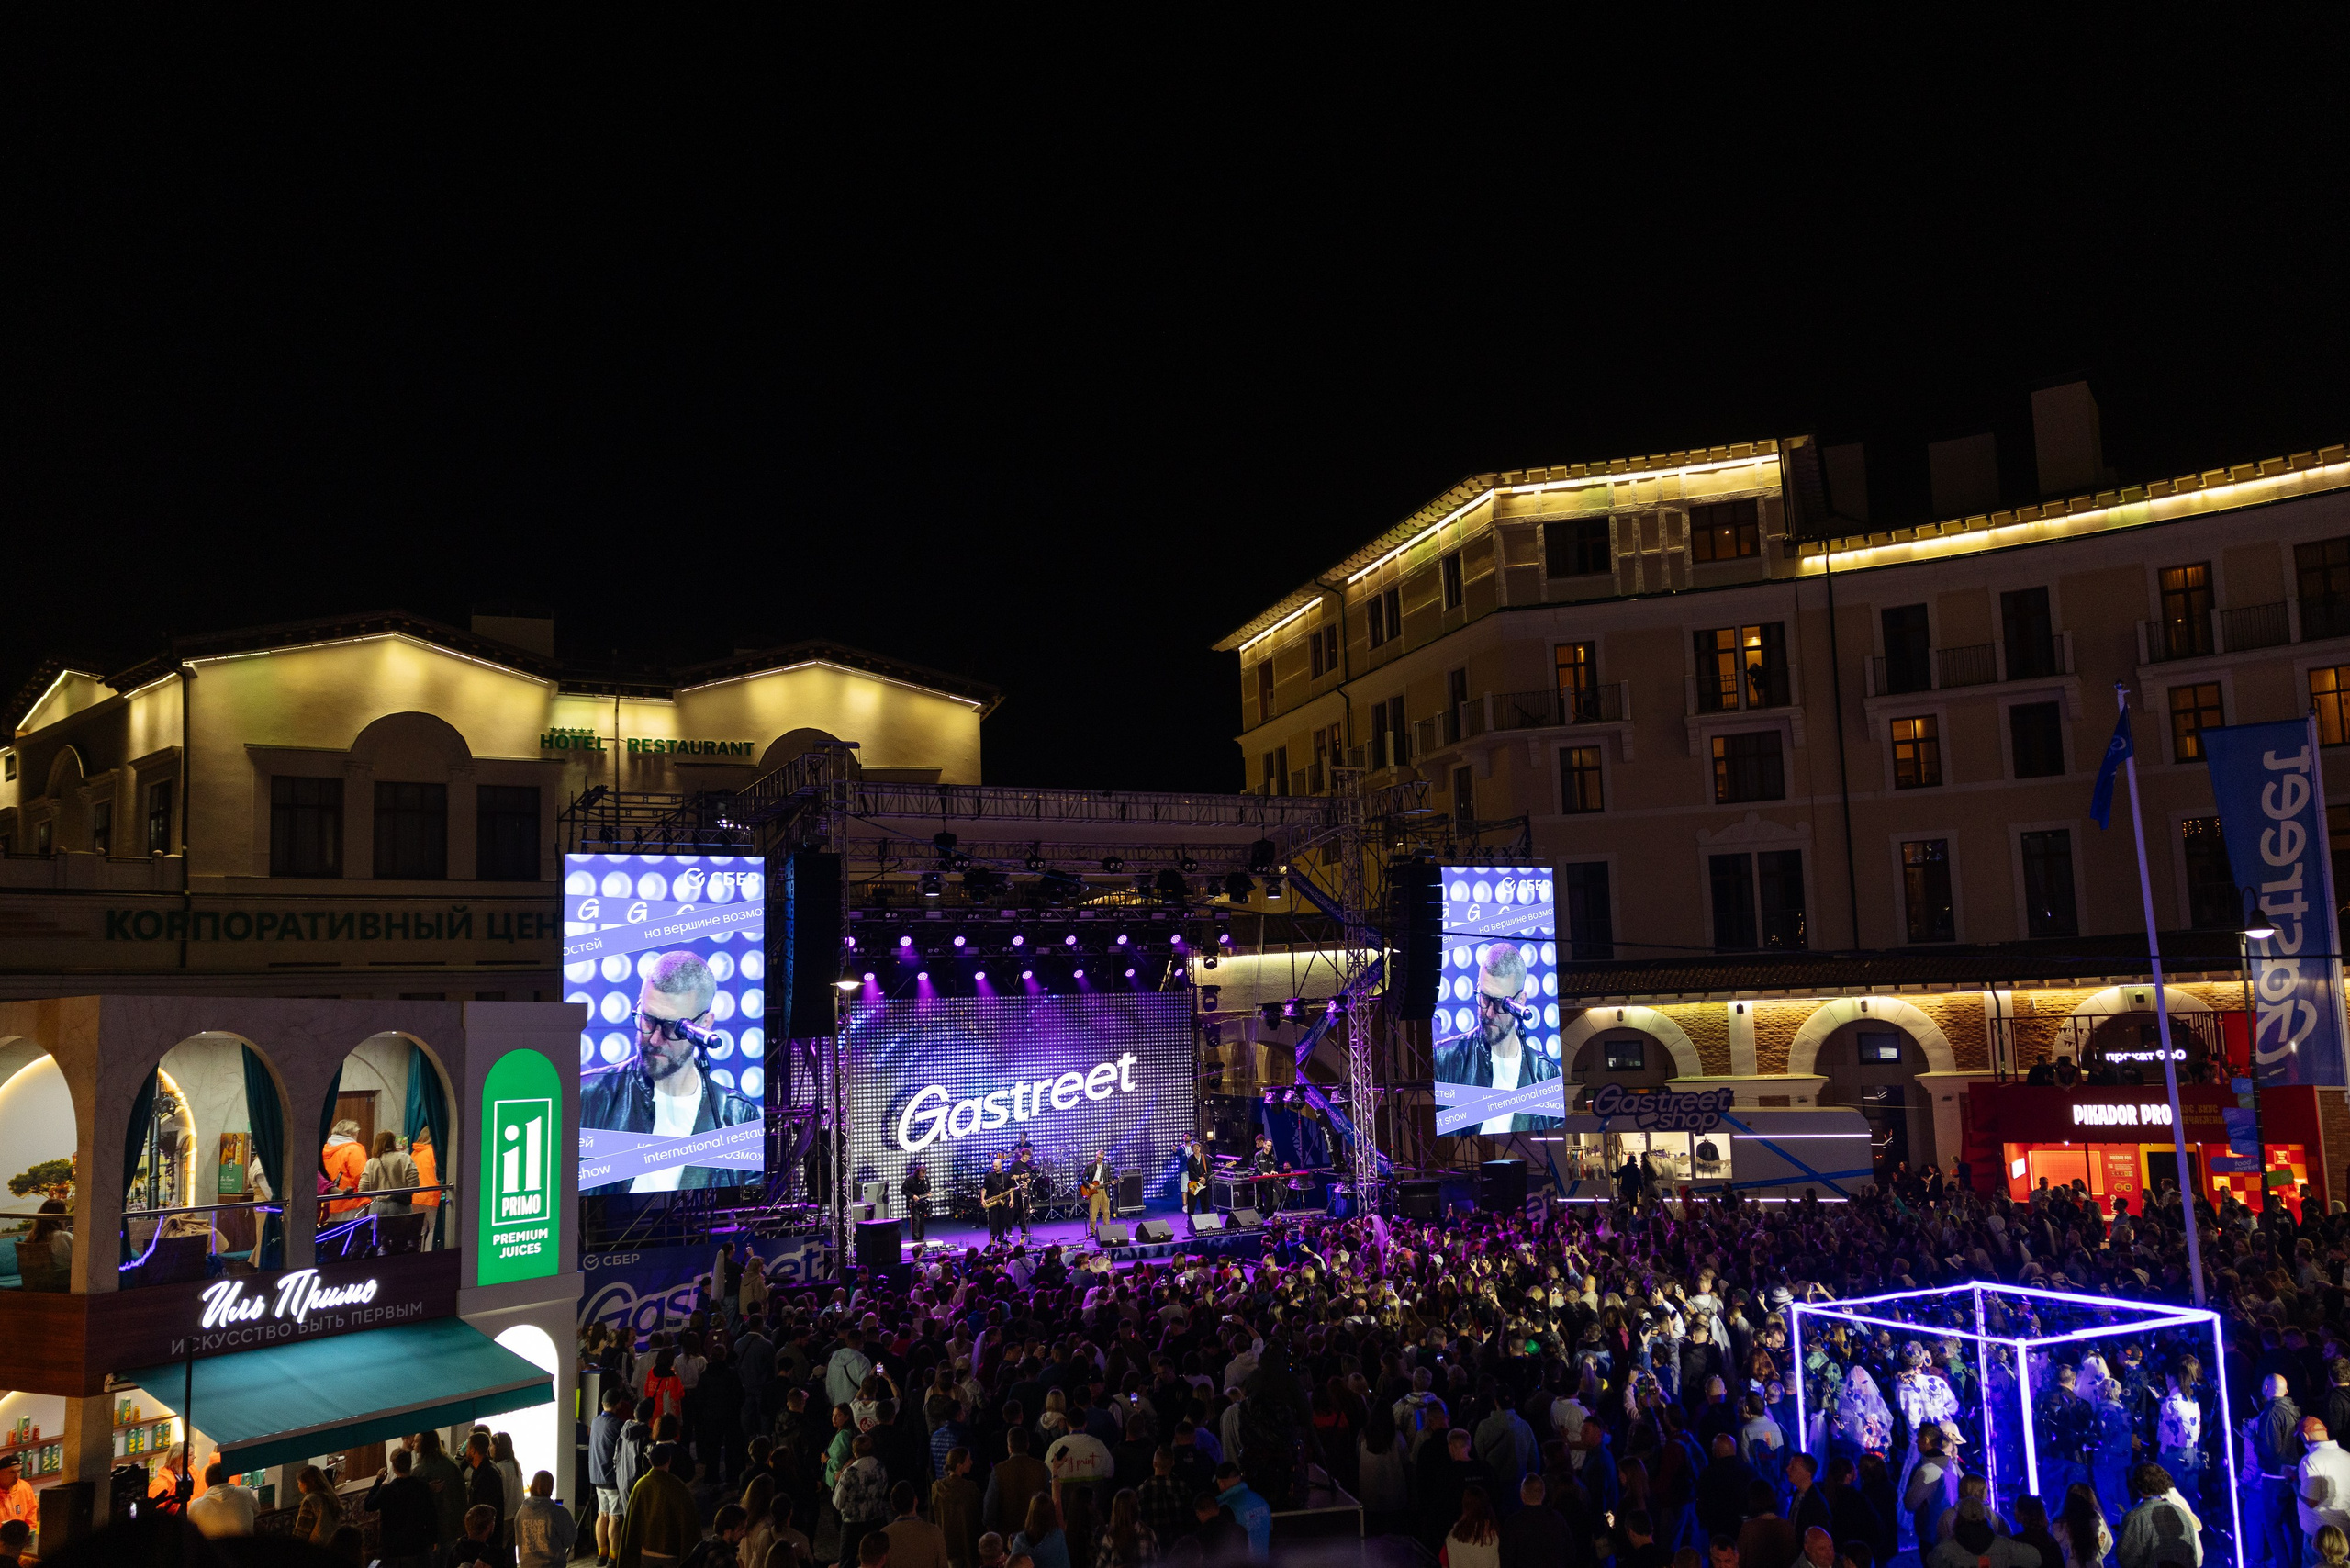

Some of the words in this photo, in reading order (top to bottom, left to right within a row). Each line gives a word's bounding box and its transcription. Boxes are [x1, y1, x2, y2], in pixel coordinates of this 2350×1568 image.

[540, 734, 607, 751] HOTEL
[627, 738, 755, 756] RESTAURANT
[710, 872, 760, 887] СБЕР
[1518, 879, 1550, 891] СБЕР
[106, 906, 473, 942] КОРПОРАТИВНЫЙ
[644, 926, 661, 939] на
[665, 915, 721, 935] вершине
[723, 907, 765, 924] возмо
[1479, 924, 1490, 934] на
[1492, 914, 1528, 931] вершине
[1528, 908, 1555, 921] возмо
[897, 1051, 1137, 1152] Gastreet
[1444, 1112, 1467, 1126] show
[1487, 1091, 1539, 1112] international
[1594, 1084, 1730, 1115] Gastreet
[1657, 1106, 1718, 1133] shop
[2072, 1104, 2138, 1126] PIKADOR
[2140, 1103, 2173, 1126] PRO
[643, 1139, 724, 1164] international
[501, 1193, 541, 1217] PRIMO
[492, 1228, 548, 1246] PREMIUM
[499, 1242, 542, 1259] JUICES
[602, 1254, 640, 1267] СБЕР
[201, 1280, 266, 1329] Иль
[274, 1268, 378, 1324] Примо
[171, 1323, 291, 1355] ИСКУССТВО
[298, 1315, 345, 1334] БЫТЬ
[351, 1301, 422, 1326] ПЕРВЫМ
[1076, 1452, 1100, 1471] print
